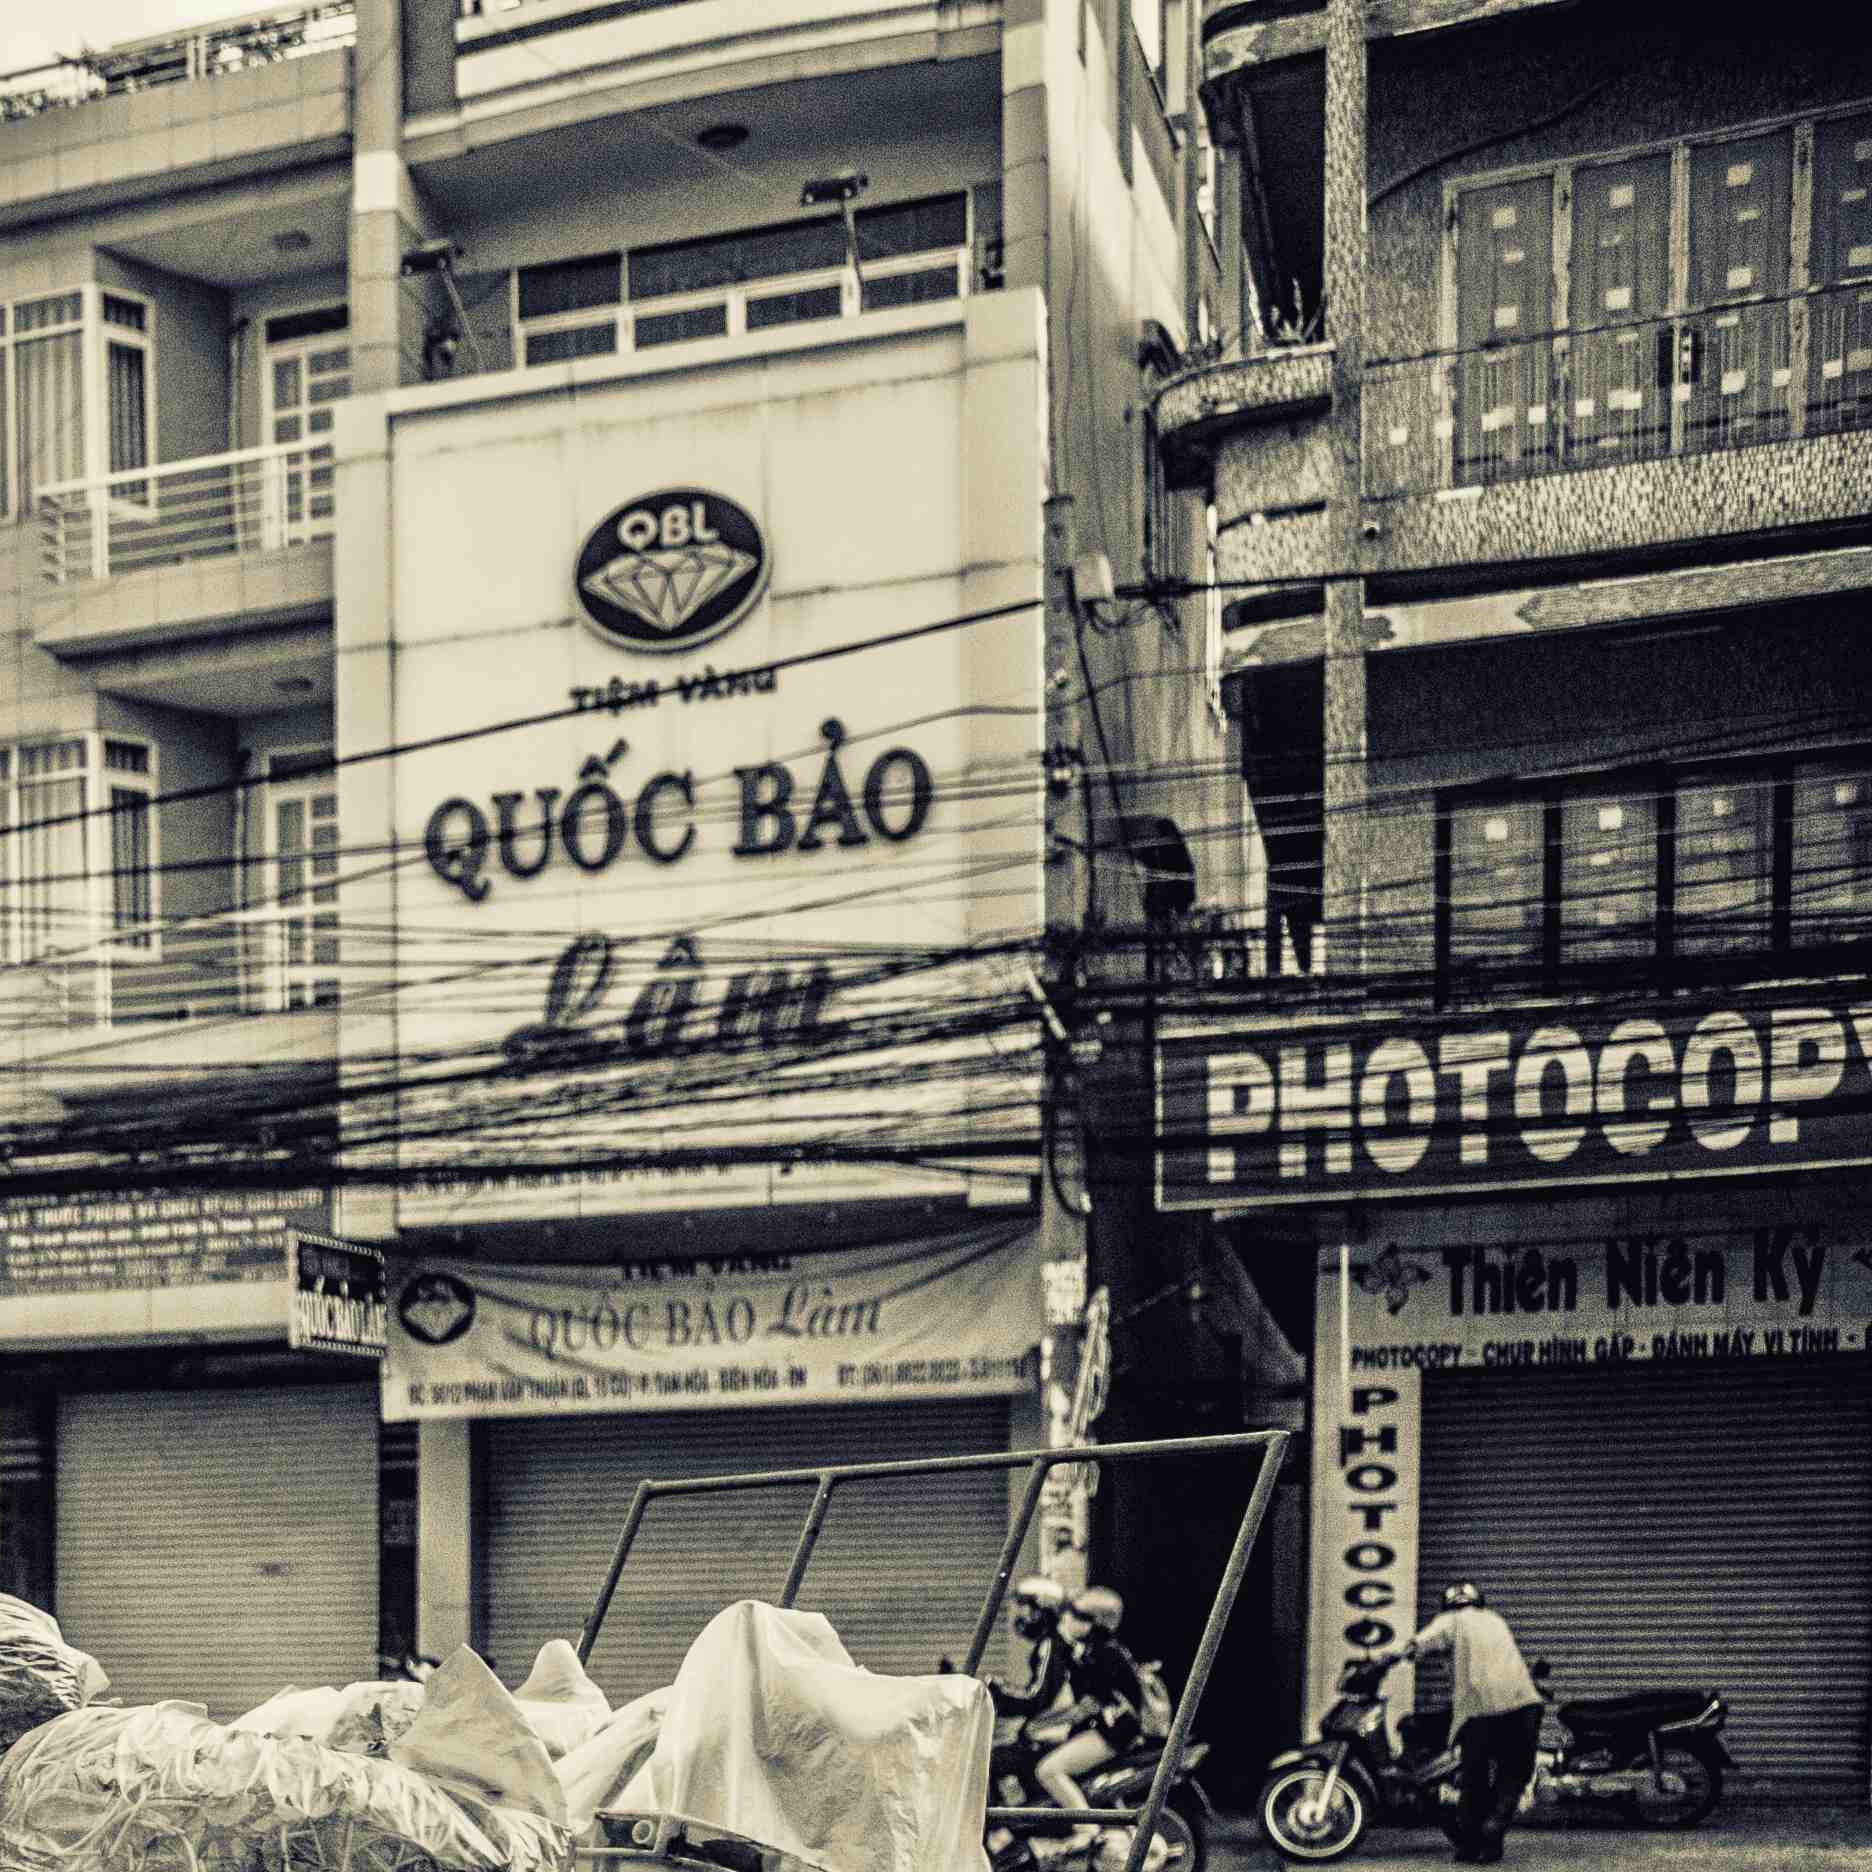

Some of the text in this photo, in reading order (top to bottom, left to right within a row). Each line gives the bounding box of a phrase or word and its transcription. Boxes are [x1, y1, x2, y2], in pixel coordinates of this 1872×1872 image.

[617, 501, 721, 550] QBL
[424, 716, 934, 901] QUỐC BẢO
[1442, 1243, 1578, 1316] Thiên
[1604, 1235, 1726, 1309] Niên
[1351, 1342, 1463, 1370] PHOTOCOPY
[1340, 1385, 1399, 1690] PHOTOCO
